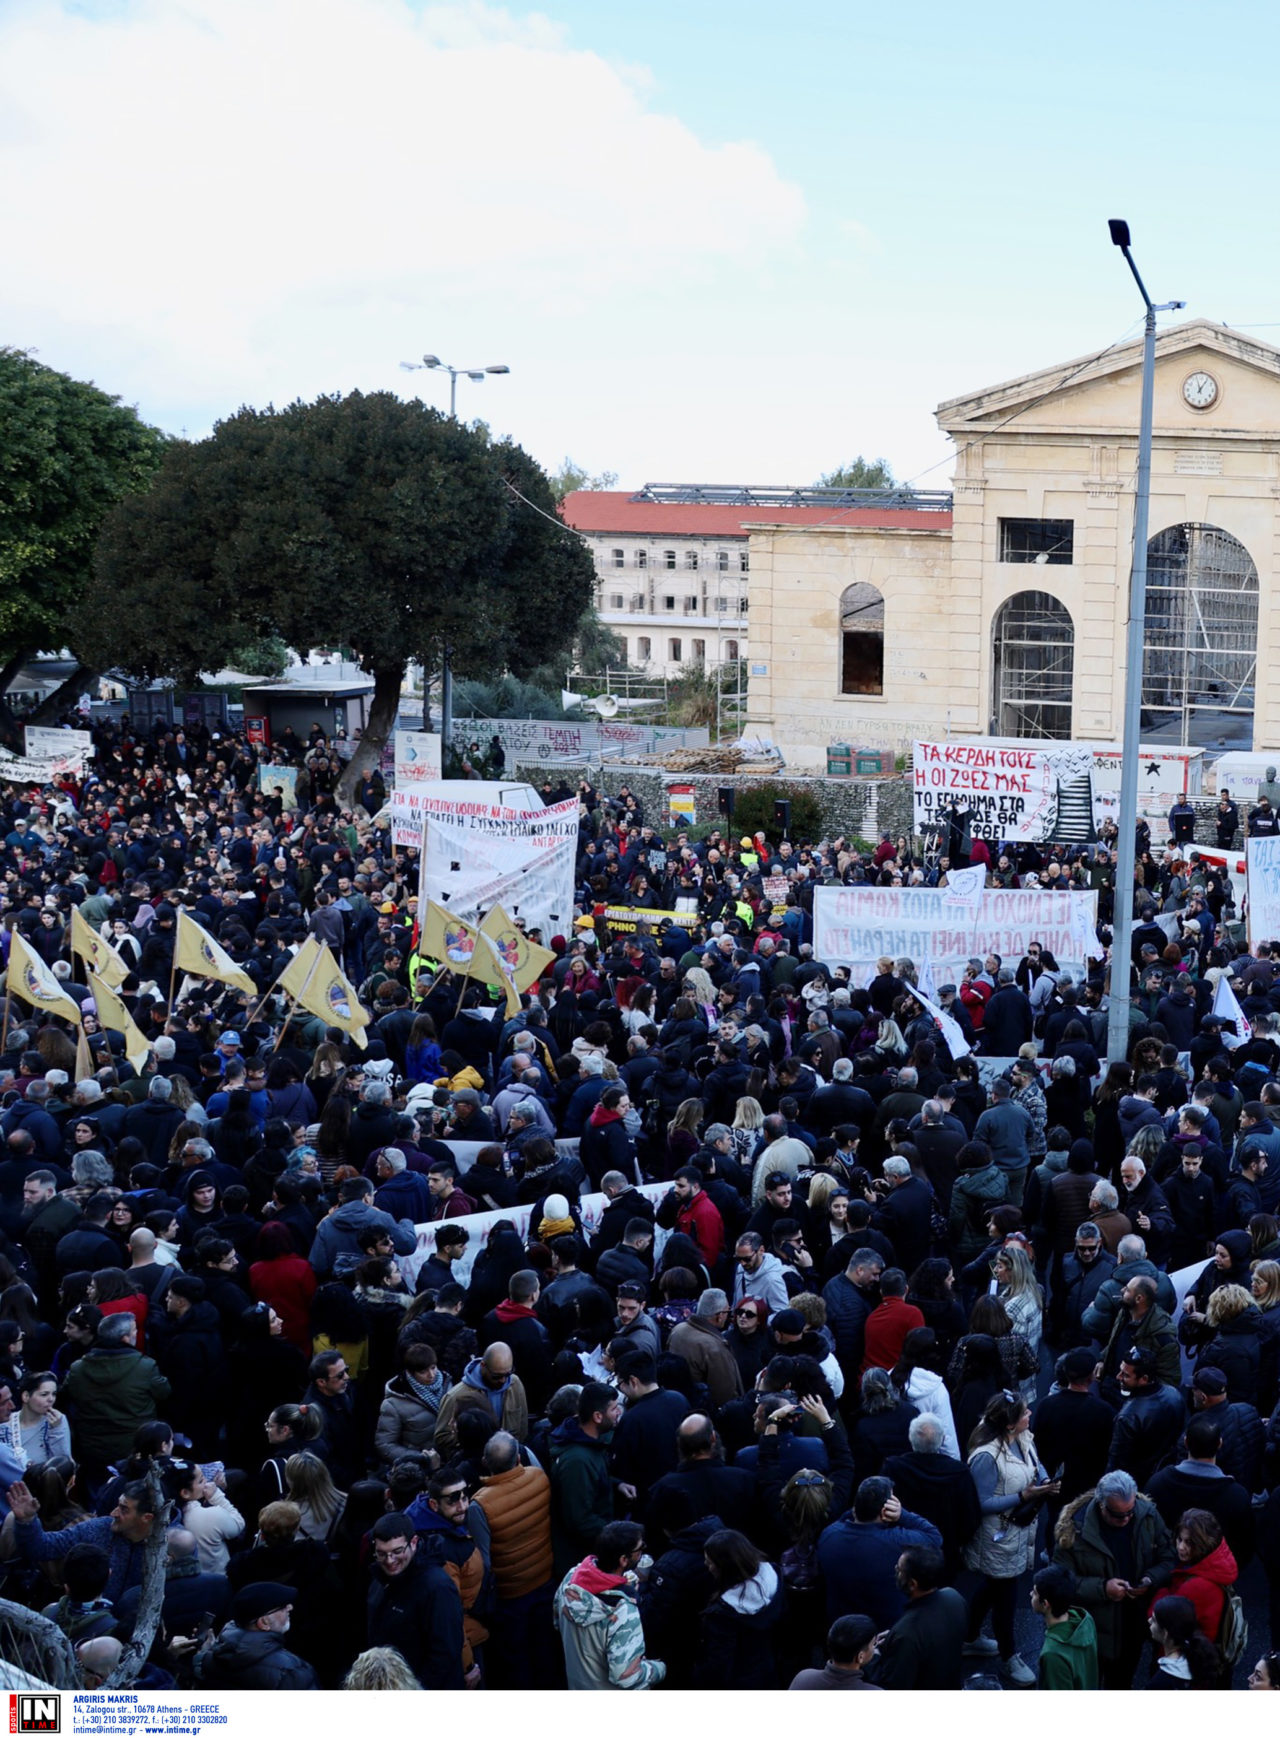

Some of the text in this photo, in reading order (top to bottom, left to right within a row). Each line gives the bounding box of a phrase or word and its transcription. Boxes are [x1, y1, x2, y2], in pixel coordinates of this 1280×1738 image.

[919, 744, 1036, 770] ΤΑ ΚΕΡΔΗ ΤΟΥΣ
[915, 768, 1032, 792] Η ΟΙ ΖΩΕΣ ΜΑΣ
[408, 795, 418, 808] ΝΑ
[490, 804, 500, 818] ΝΑ
[915, 792, 932, 807] ΤΟ
[999, 795, 1024, 812] ΣΤΑ
[410, 809, 421, 821] ΝΑ
[458, 816, 464, 828] Η
[998, 812, 1018, 826] ΘΑ
